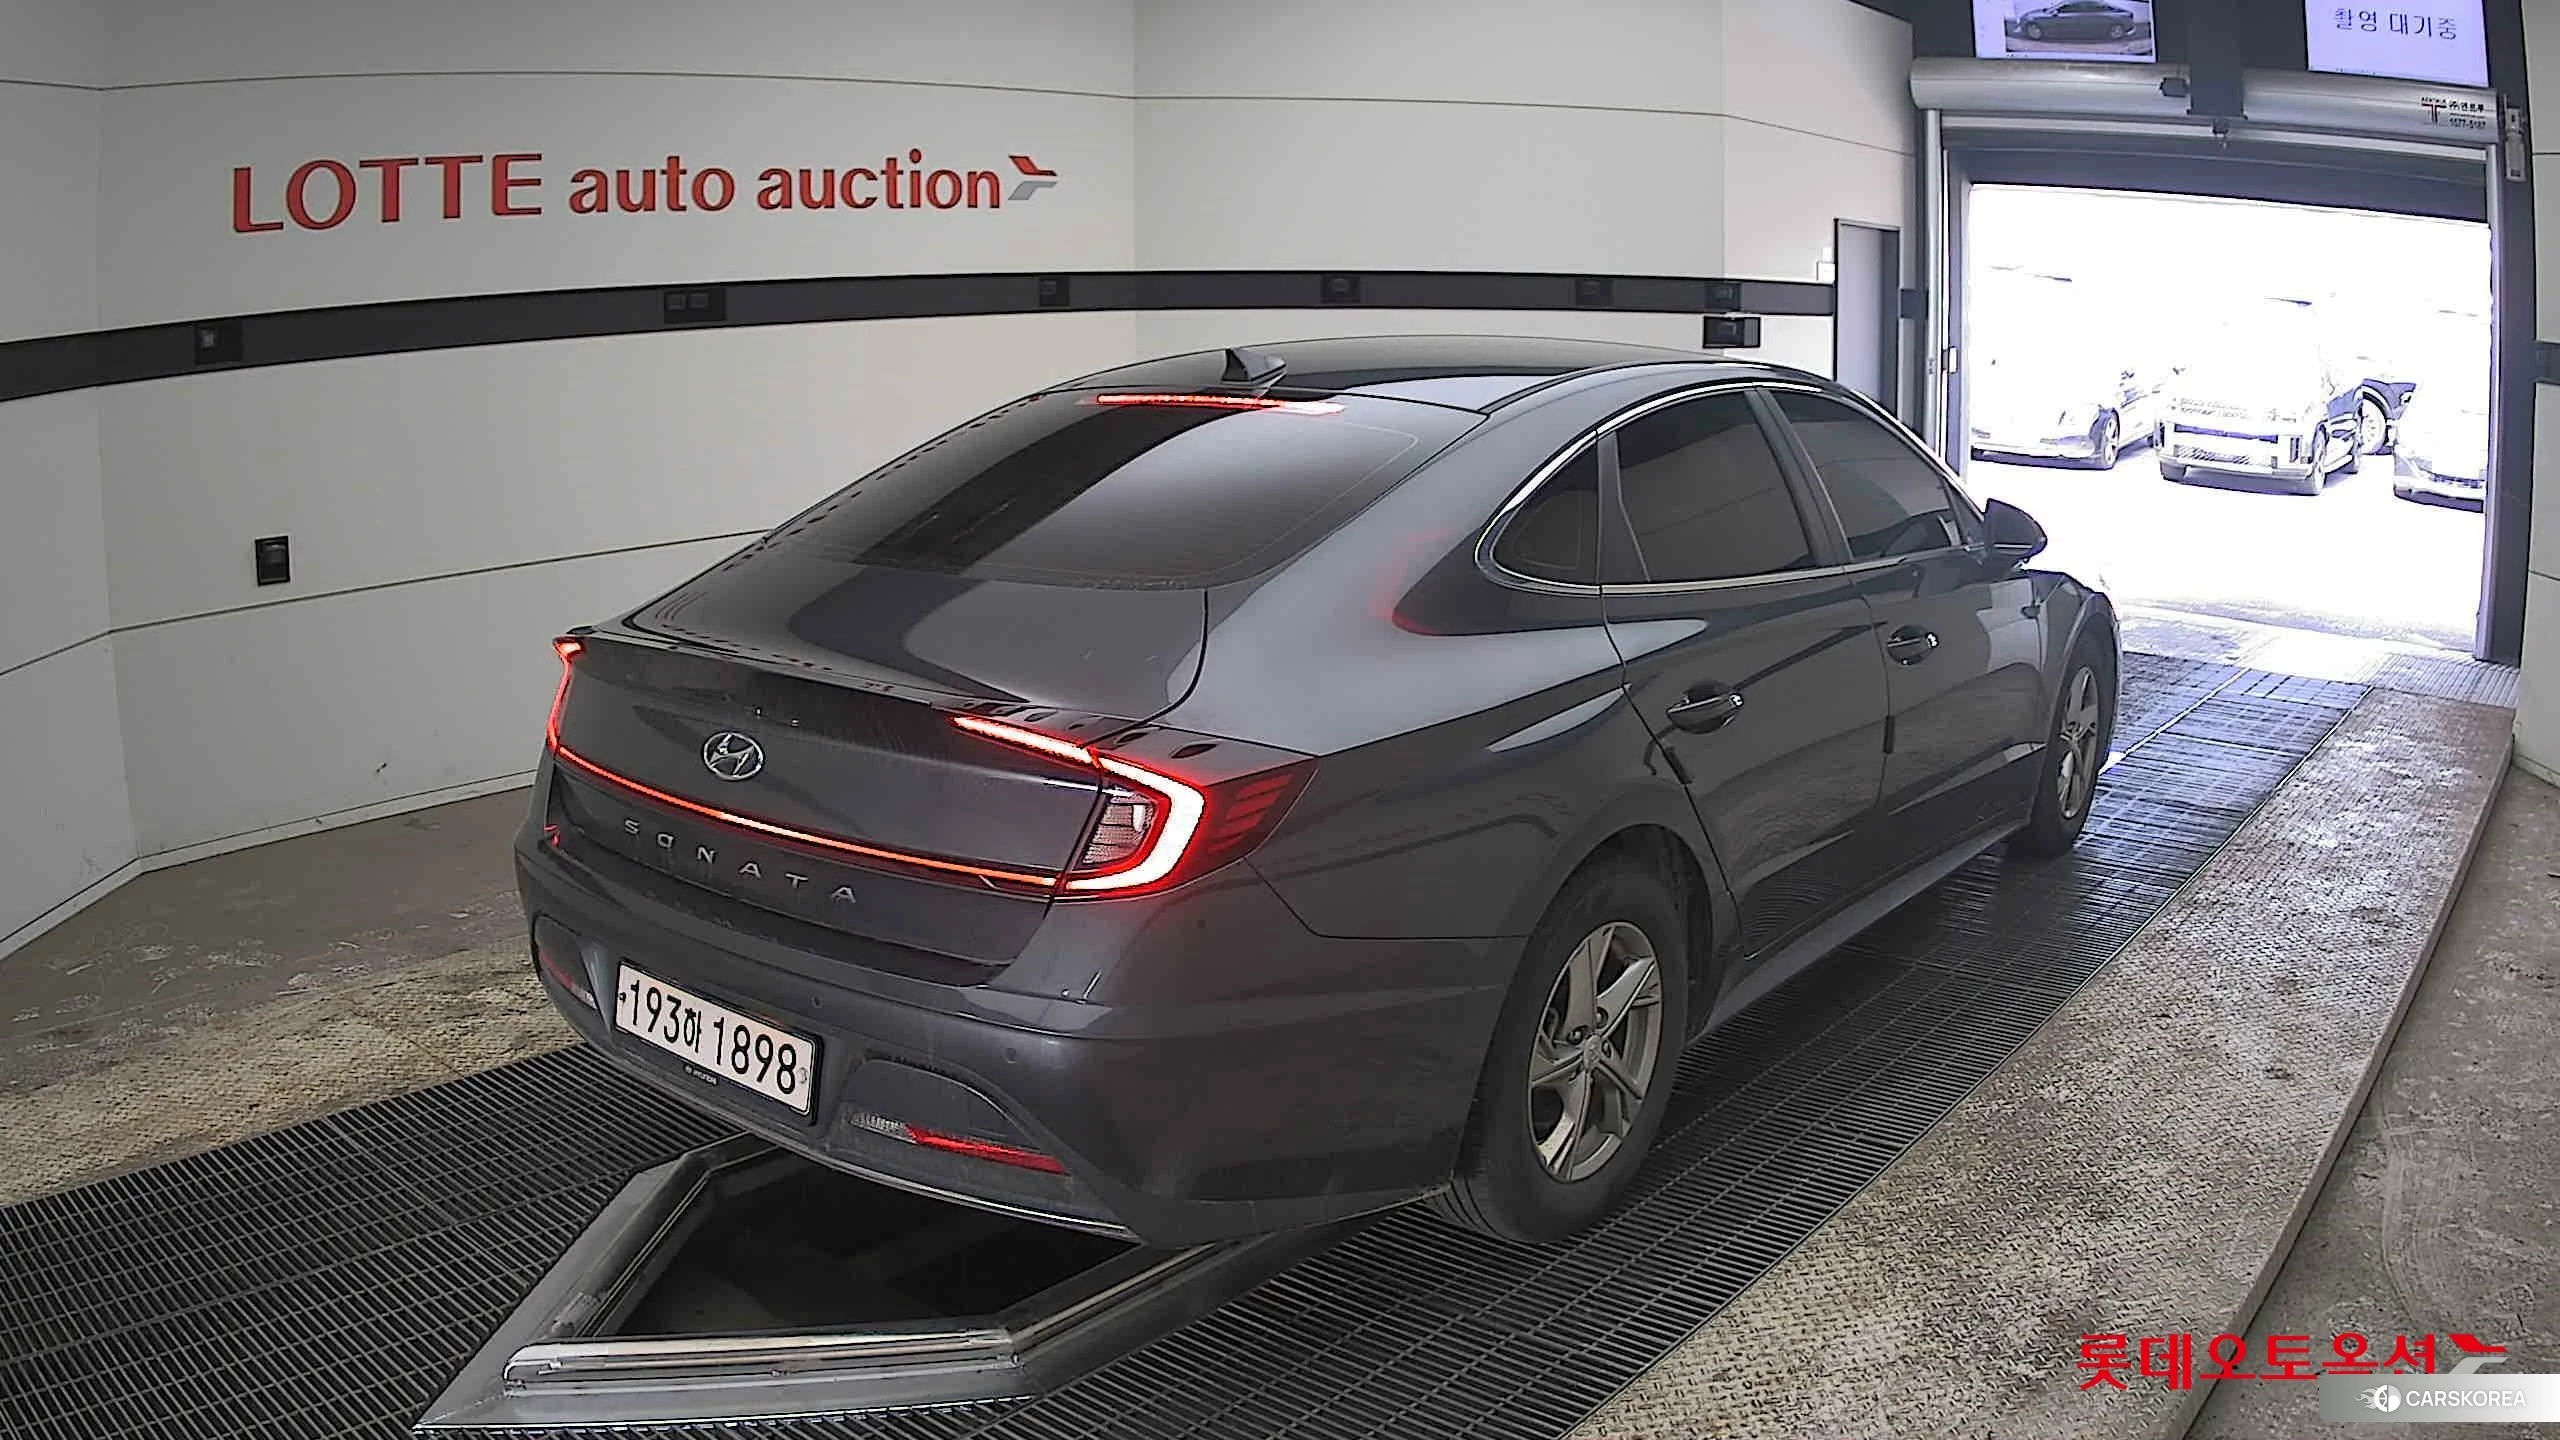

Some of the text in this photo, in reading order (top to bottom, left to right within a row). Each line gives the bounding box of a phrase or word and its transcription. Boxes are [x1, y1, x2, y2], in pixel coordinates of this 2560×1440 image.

[2389, 12, 2457, 40] 대기중
[233, 147, 1001, 233] LOTTE auto auction
[623, 817, 857, 904] SONATA
[629, 979, 797, 1095] 193하 1898
